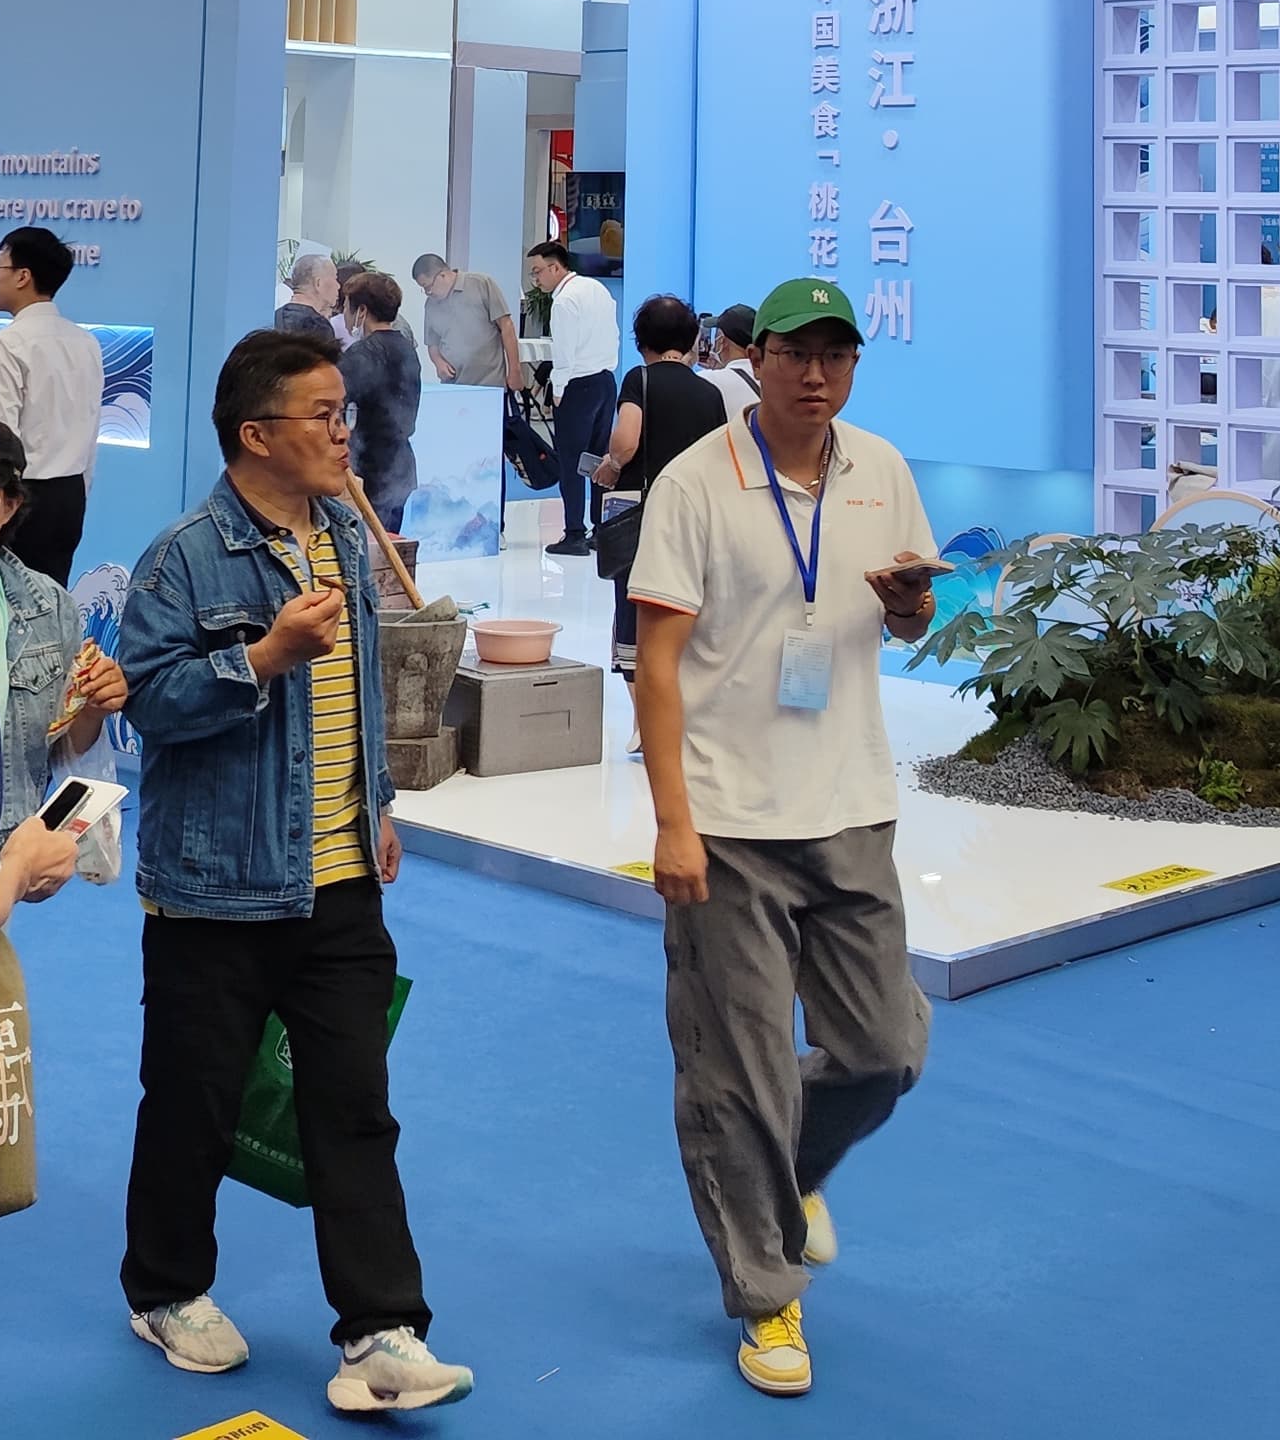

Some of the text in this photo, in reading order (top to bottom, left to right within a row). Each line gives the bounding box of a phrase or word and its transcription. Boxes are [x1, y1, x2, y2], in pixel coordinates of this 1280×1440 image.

[3, 146, 101, 177] mountains
[26, 198, 61, 225] you
[62, 198, 119, 221] crave
[119, 194, 142, 221] to
